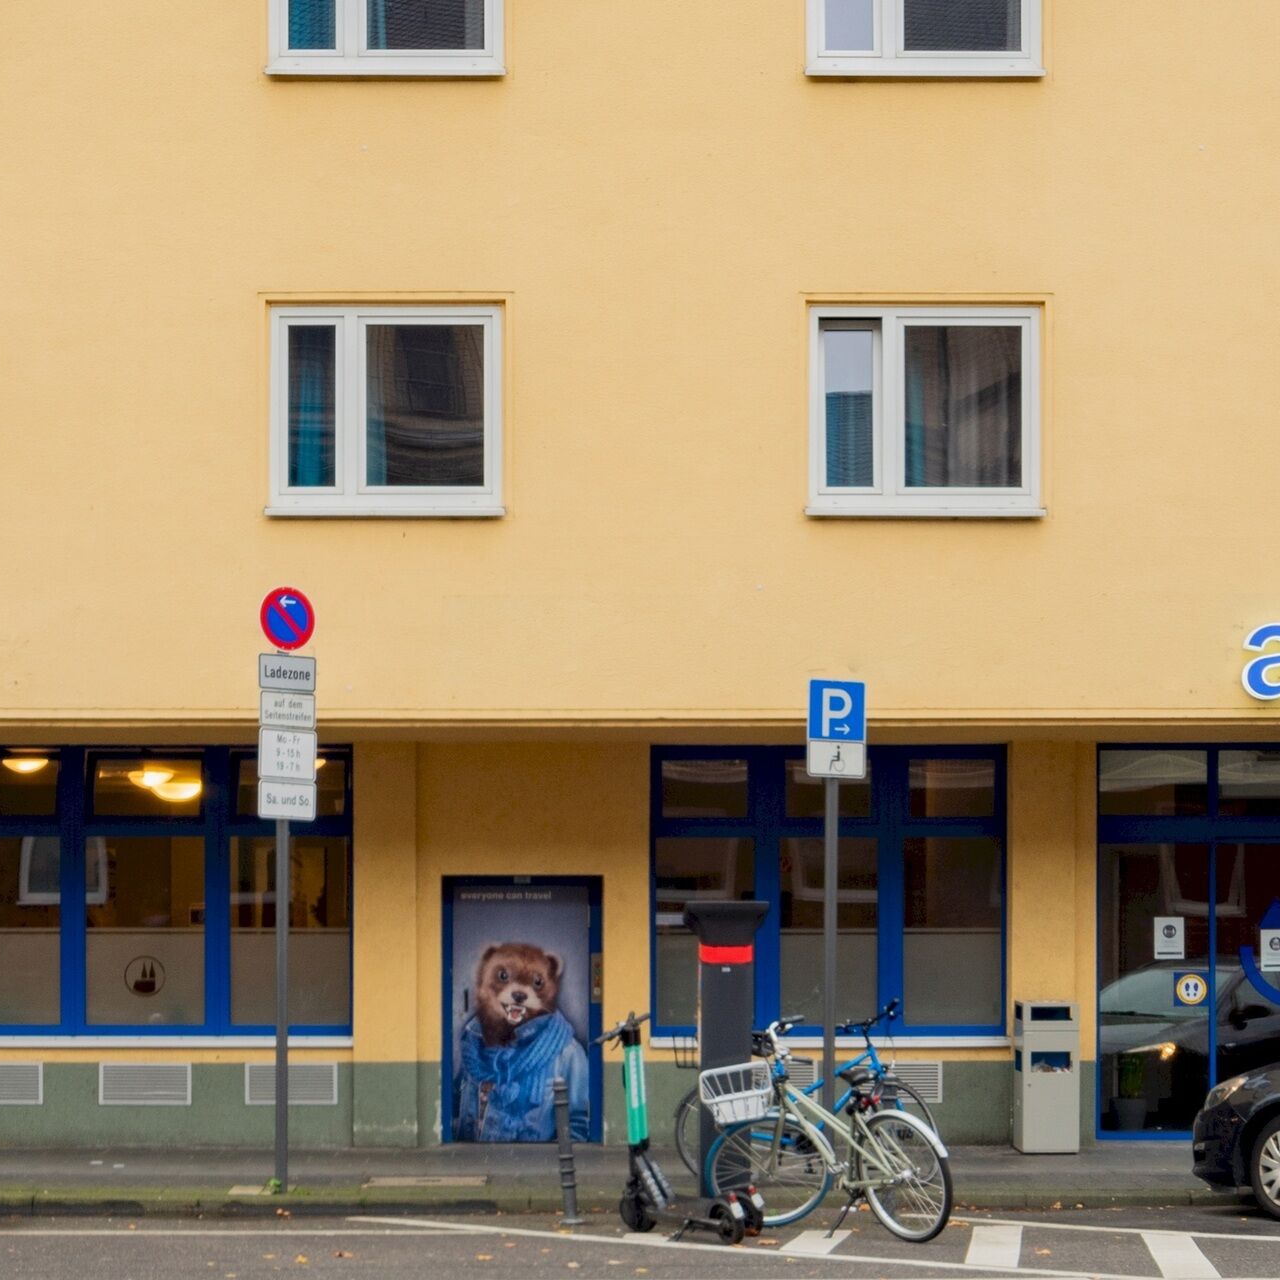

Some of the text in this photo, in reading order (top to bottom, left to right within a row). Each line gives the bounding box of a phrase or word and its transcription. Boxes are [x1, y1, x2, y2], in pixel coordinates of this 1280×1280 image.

[264, 664, 311, 681] Ladezone
[274, 698, 303, 709] auf dem
[264, 709, 312, 722] Seitenstreifen
[822, 688, 852, 737] P
[266, 793, 312, 807] Sa. und So.
[460, 890, 552, 901] everyone can travel
